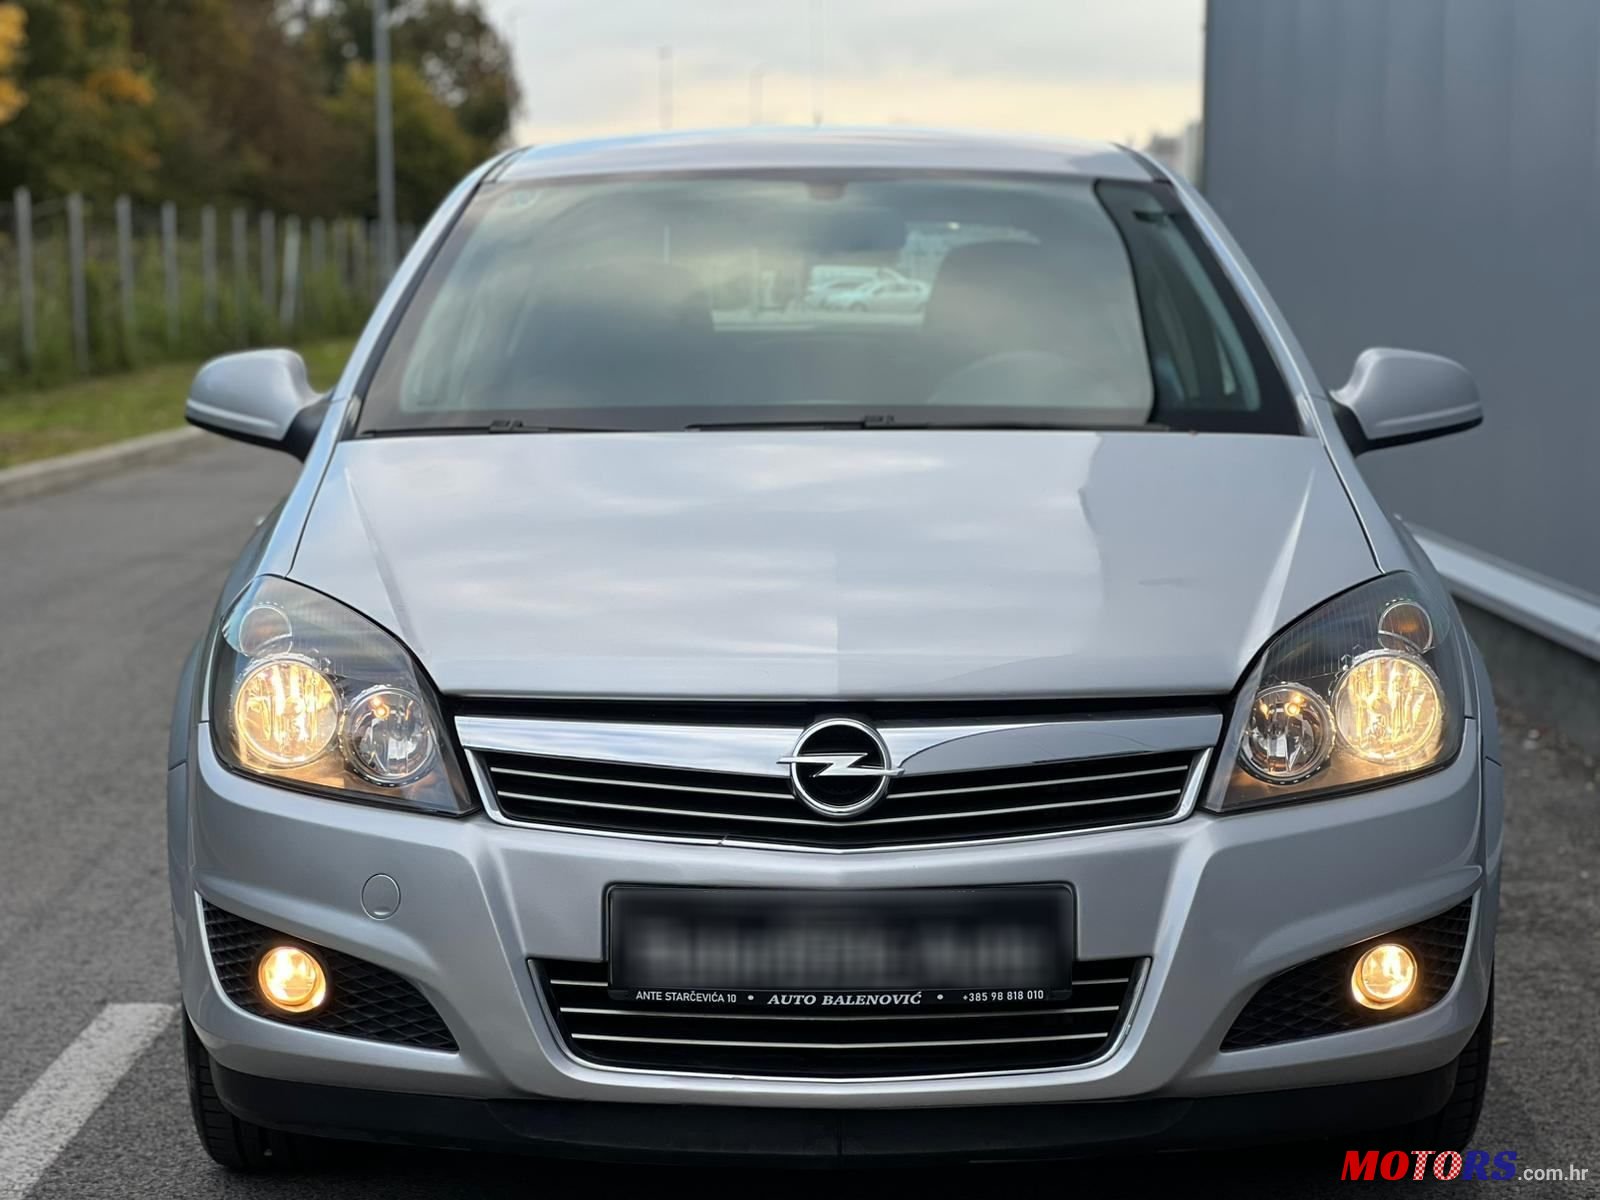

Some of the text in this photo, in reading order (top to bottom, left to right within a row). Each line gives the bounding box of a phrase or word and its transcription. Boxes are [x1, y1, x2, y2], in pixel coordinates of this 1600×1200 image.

[635, 989, 1044, 1006] ANTE STARČEVIĆA 10 AUTO BALENOVIĆ +385 98 818 010
